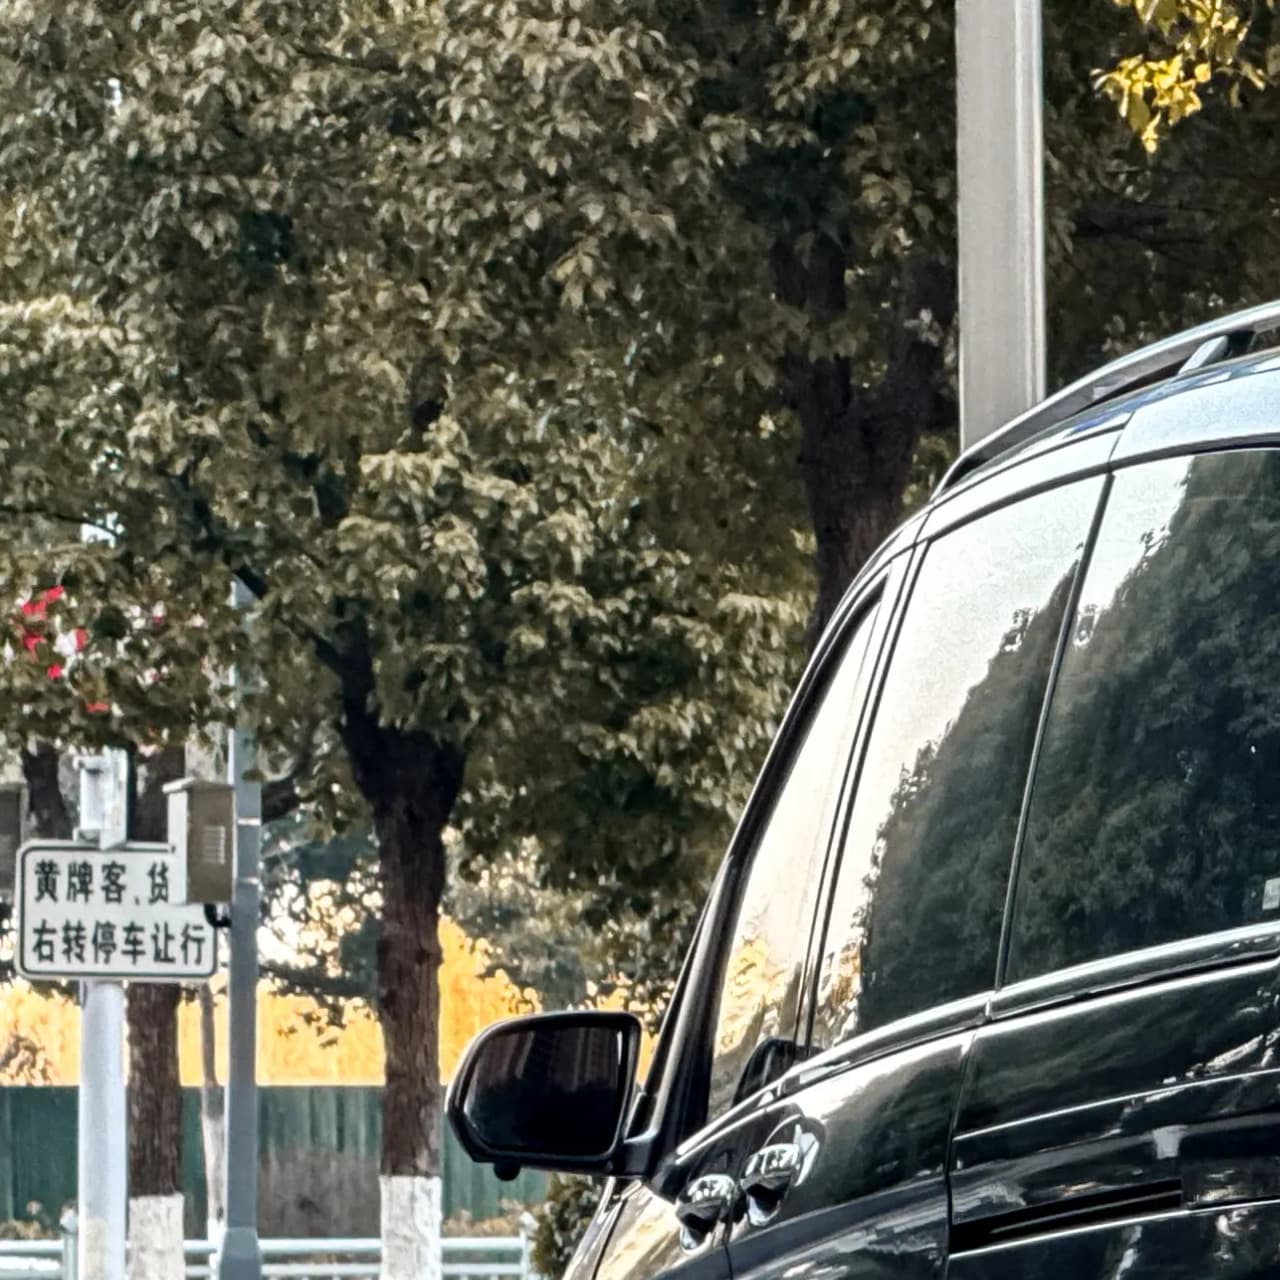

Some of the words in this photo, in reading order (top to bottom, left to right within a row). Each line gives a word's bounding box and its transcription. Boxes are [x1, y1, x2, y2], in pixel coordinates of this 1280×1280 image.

[33, 919, 205, 965] 右转停车让行
